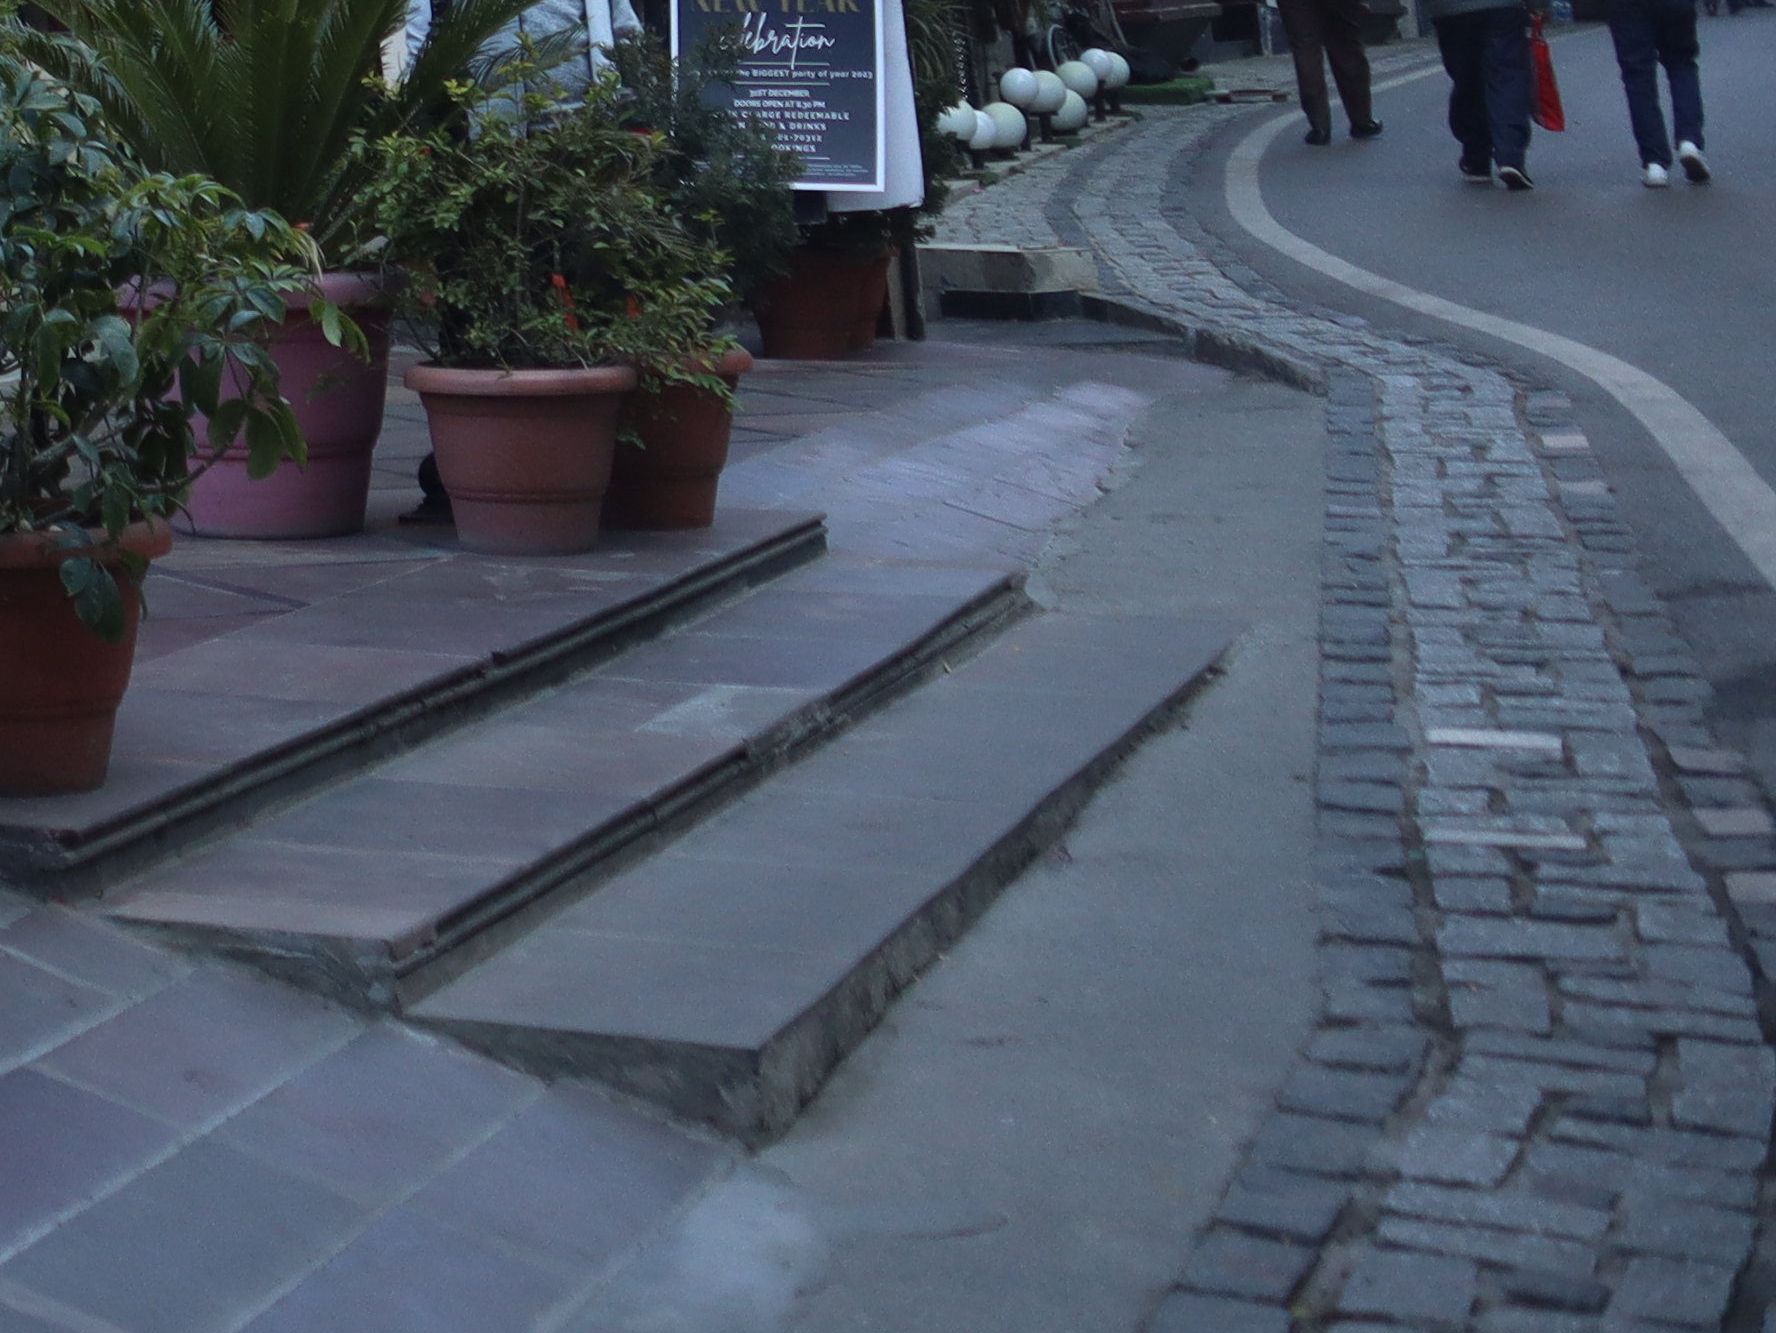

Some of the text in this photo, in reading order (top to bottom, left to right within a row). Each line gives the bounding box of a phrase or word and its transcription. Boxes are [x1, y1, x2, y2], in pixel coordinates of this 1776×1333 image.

[719, 11, 836, 70] ebration
[752, 69, 791, 78] BIGGEST
[792, 70, 816, 79] party
[817, 69, 828, 78] of
[829, 71, 849, 80] year
[768, 89, 811, 98] DECEMBER
[762, 99, 783, 108] OPEN
[741, 111, 781, 120] CARGE
[784, 111, 850, 120] REDEEMABLE
[789, 122, 827, 131] DRINKS
[770, 144, 816, 153] OOKNGS
